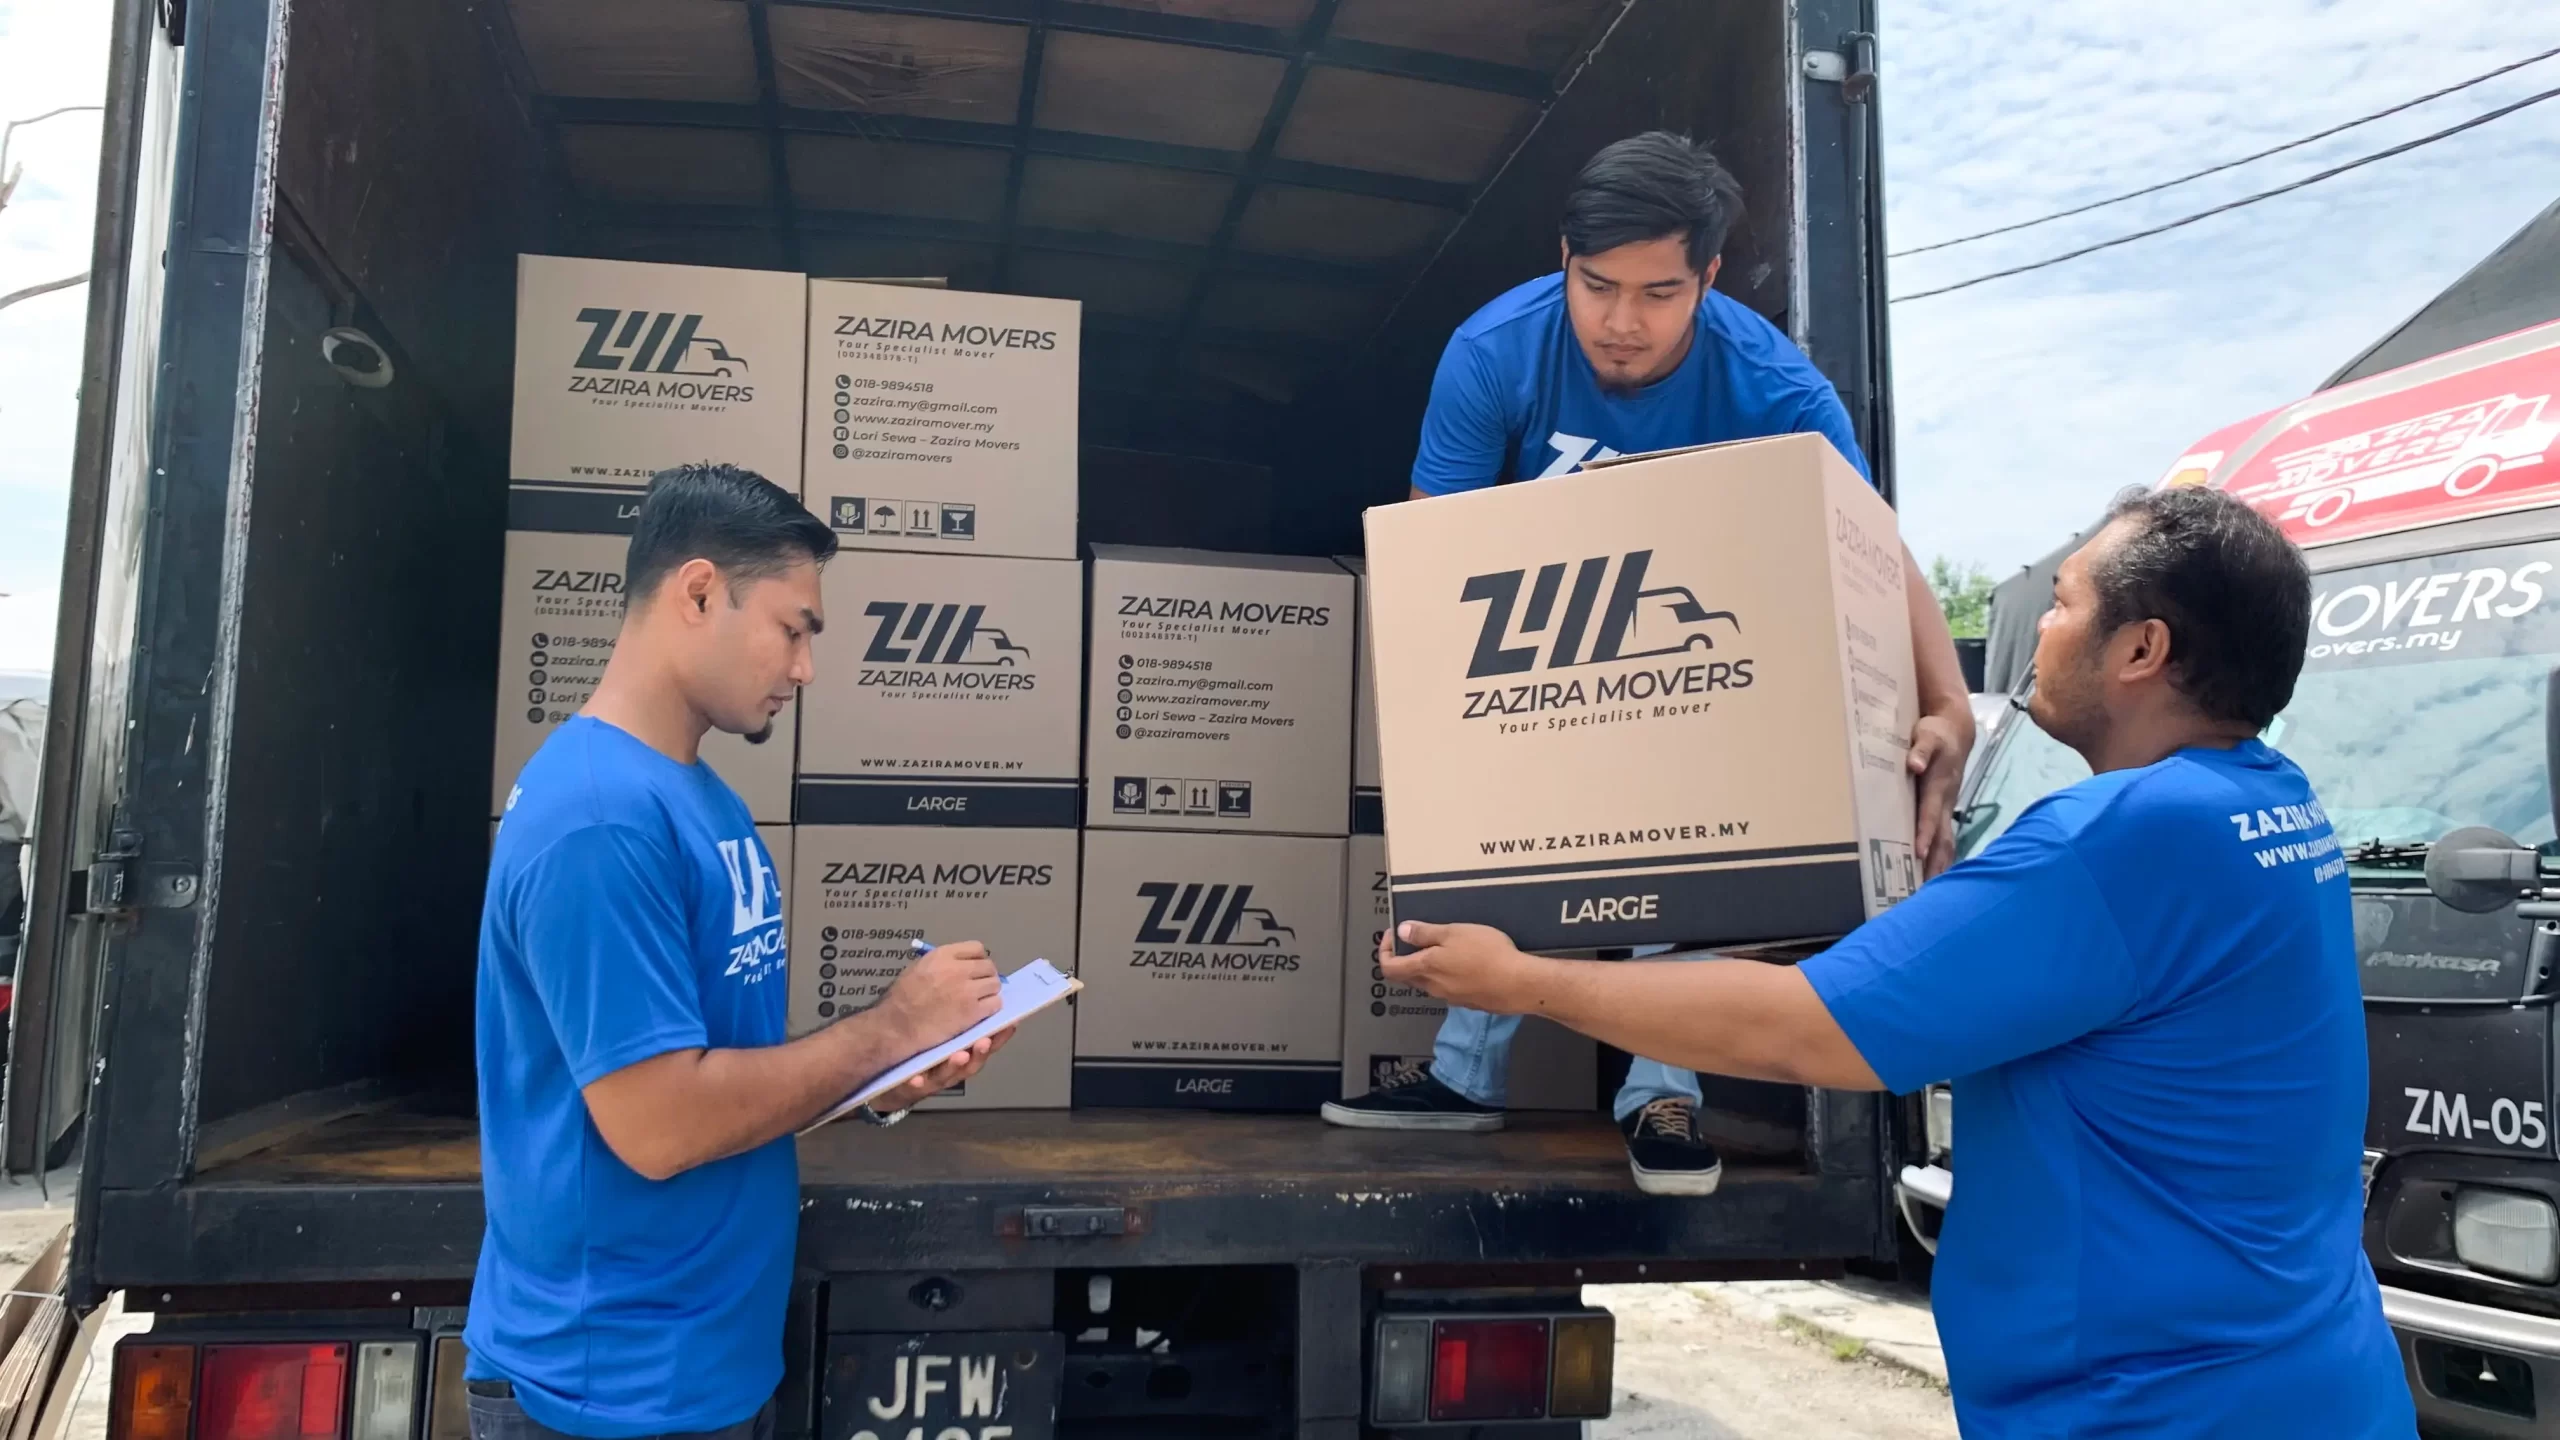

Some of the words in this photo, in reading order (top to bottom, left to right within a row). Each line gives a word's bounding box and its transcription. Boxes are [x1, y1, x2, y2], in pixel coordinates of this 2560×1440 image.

[834, 315, 934, 342] ZAZIRA
[941, 323, 1057, 351] MOVERS
[838, 339, 870, 350] Your
[876, 342, 947, 356] Specialist
[953, 348, 996, 359] Mover
[568, 376, 651, 397] ZAZIRA
[657, 381, 754, 403] MOVERS
[854, 378, 934, 393] 018-9894518
[592, 398, 618, 408] Your
[624, 400, 685, 412] Specialist
[691, 404, 727, 413] Mover
[853, 396, 998, 415] zazira.my@gmail.com
[853, 415, 995, 433] www.zaziramover.my
[852, 430, 878, 441] Lori
[881, 432, 916, 444] Sewa
[930, 435, 971, 447] Zazira
[975, 439, 1020, 451] Movers
[852, 448, 953, 464] @zaziramovers
[532, 570, 625, 594] ZAZIR
[536, 595, 570, 605] Your
[1118, 596, 1214, 620] ZAZIRA
[1220, 602, 1330, 626] MOVERS
[1122, 620, 1152, 630] Your
[1158, 621, 1225, 634] Specialist
[1232, 626, 1271, 636] Mover
[2306, 629, 2462, 658] overs.my
[1137, 658, 1213, 671] 018-9894518
[857, 670, 938, 688] ZAZIRA
[942, 672, 1036, 690] MOVERS
[1135, 676, 1274, 692] zazira.my@gmail.com
[550, 692, 577, 703] Lori
[880, 690, 906, 698] Your
[911, 691, 971, 701] Specialist
[975, 692, 1011, 701] Mover
[1462, 680, 1587, 720] ZAZIRA
[1596, 659, 1754, 705] MOVERS
[1135, 694, 1270, 710] www.zaziramover.my
[1135, 710, 1159, 721] Lori
[1162, 712, 1196, 723] Sewa
[1209, 713, 1248, 725] Zazira
[1251, 715, 1295, 727] Movers
[1499, 719, 1539, 734] Your
[1548, 708, 1643, 731] Specialist
[1653, 701, 1712, 719] Mover
[1134, 727, 1230, 741] @zaziramovers
[861, 759, 1024, 770] WWW.ZAZIRAMOVER.MY
[907, 797, 967, 811] LARGE
[1480, 821, 1750, 855] WWW.ZAZIRAMOVER.MY
[821, 862, 926, 885] ZAZIRA
[932, 864, 1053, 886] MOVERS
[825, 889, 858, 898] Your
[864, 888, 938, 900] Specialist
[945, 890, 989, 899] Mover
[1560, 894, 1660, 925] LARGE
[841, 929, 925, 940] 018-9894518
[1129, 950, 1206, 969] ZAZIRA
[1210, 953, 1301, 972] MOVERS
[1151, 972, 1176, 981] Your
[1181, 972, 1237, 983] Specialist
[1242, 974, 1276, 983] Mover
[838, 985, 865, 996] Lori
[1132, 1041, 1289, 1053] WWW.ZAZIRAMOVER.MY
[1175, 1078, 1233, 1094] LARGE
[2404, 1087, 2546, 1149] ZM-05
[867, 1355, 996, 1420] JFW
